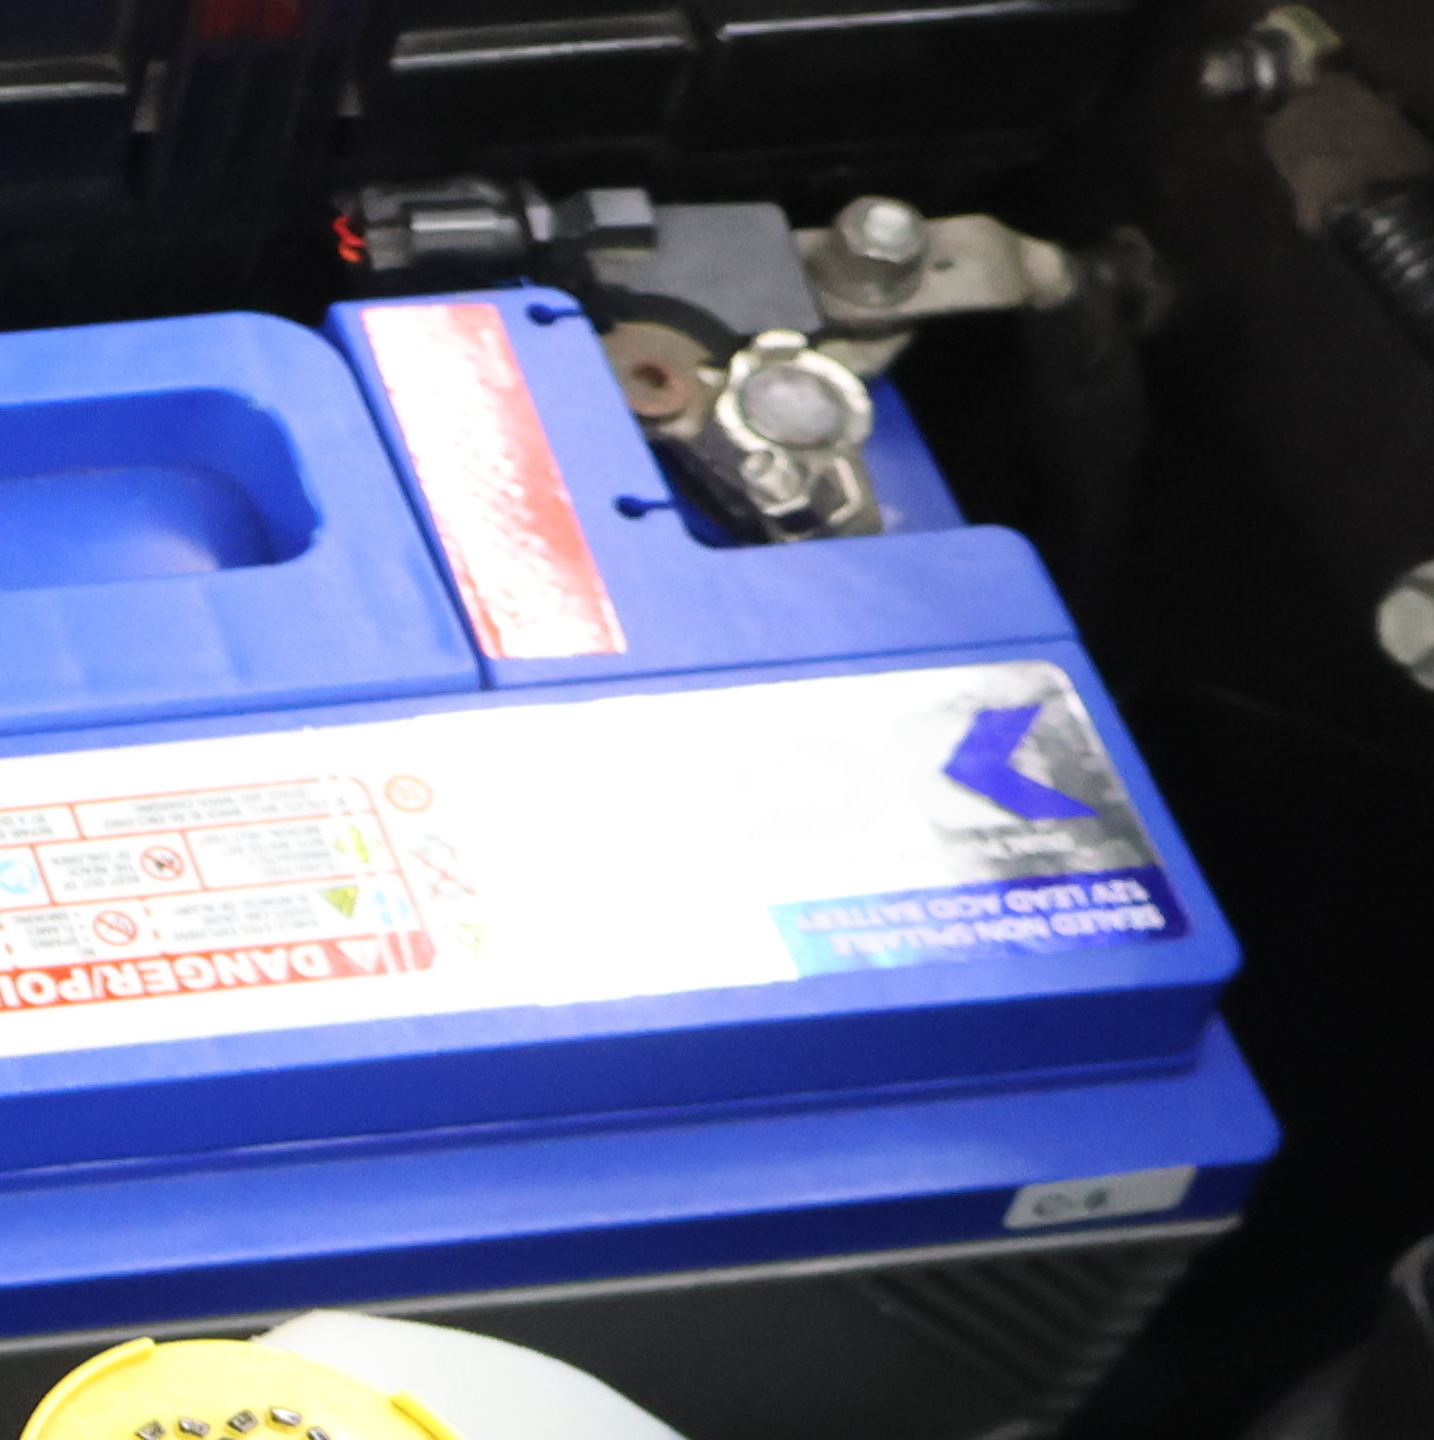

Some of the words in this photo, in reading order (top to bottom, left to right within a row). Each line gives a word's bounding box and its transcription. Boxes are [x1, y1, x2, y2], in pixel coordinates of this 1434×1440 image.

[924, 892, 1006, 921] ACID
[1003, 884, 1088, 912] LEAD
[793, 900, 925, 933] BATTERY
